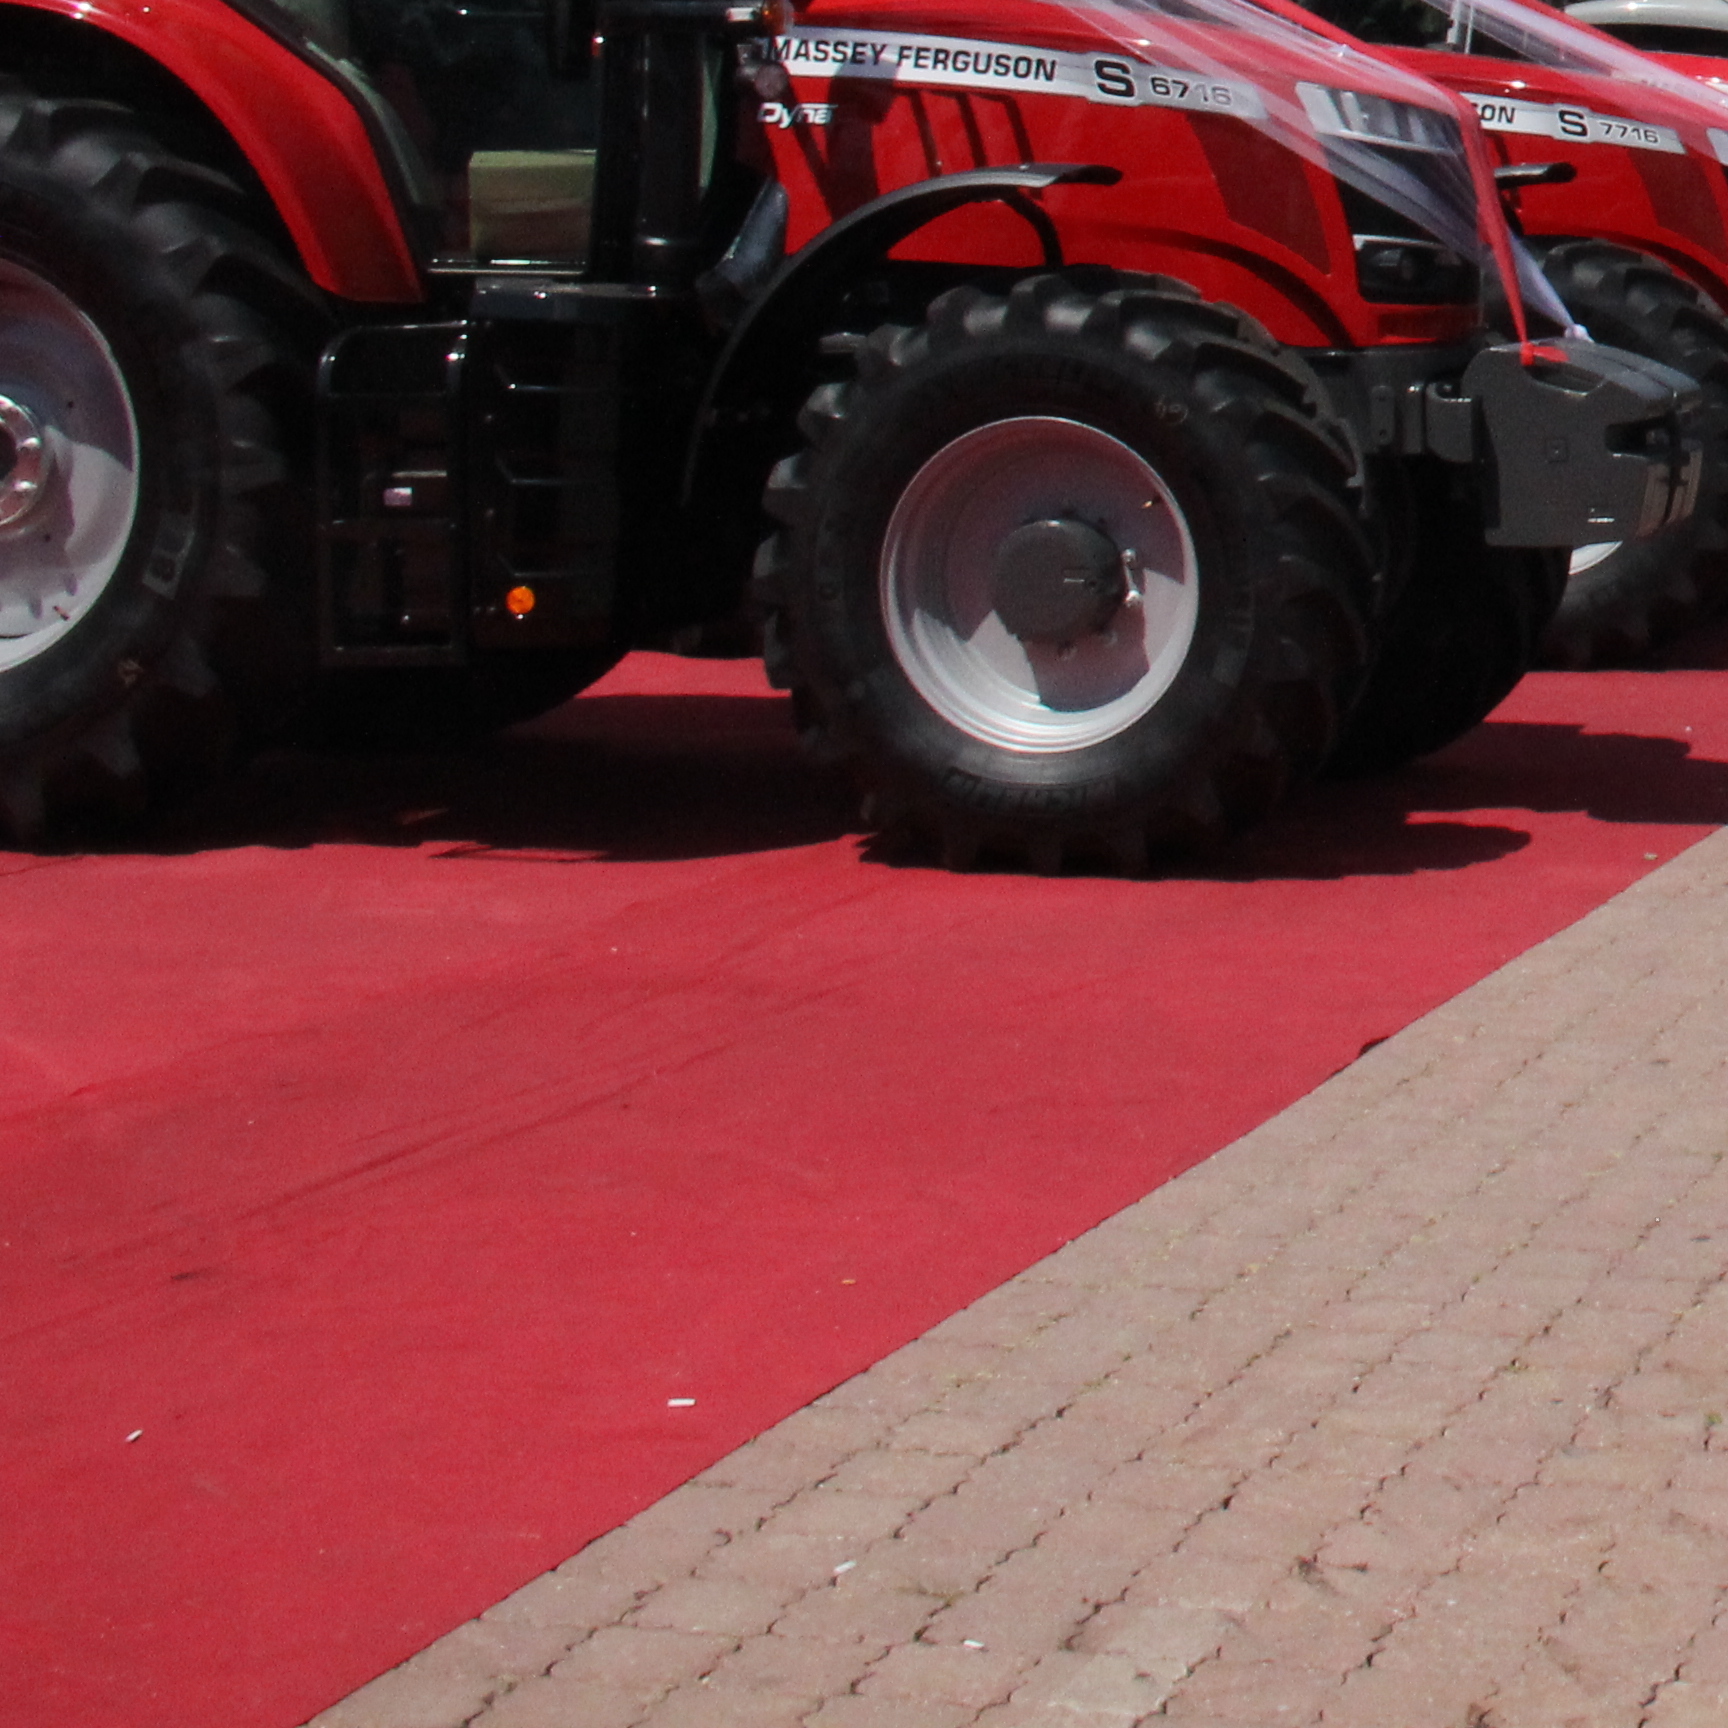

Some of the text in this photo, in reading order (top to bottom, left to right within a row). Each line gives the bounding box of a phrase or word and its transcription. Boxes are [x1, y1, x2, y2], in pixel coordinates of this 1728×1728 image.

[766, 37, 1232, 106] MASSEY FERGUSON S 6716
[1558, 110, 1588, 138] S
[1598, 121, 1660, 144] 7716
